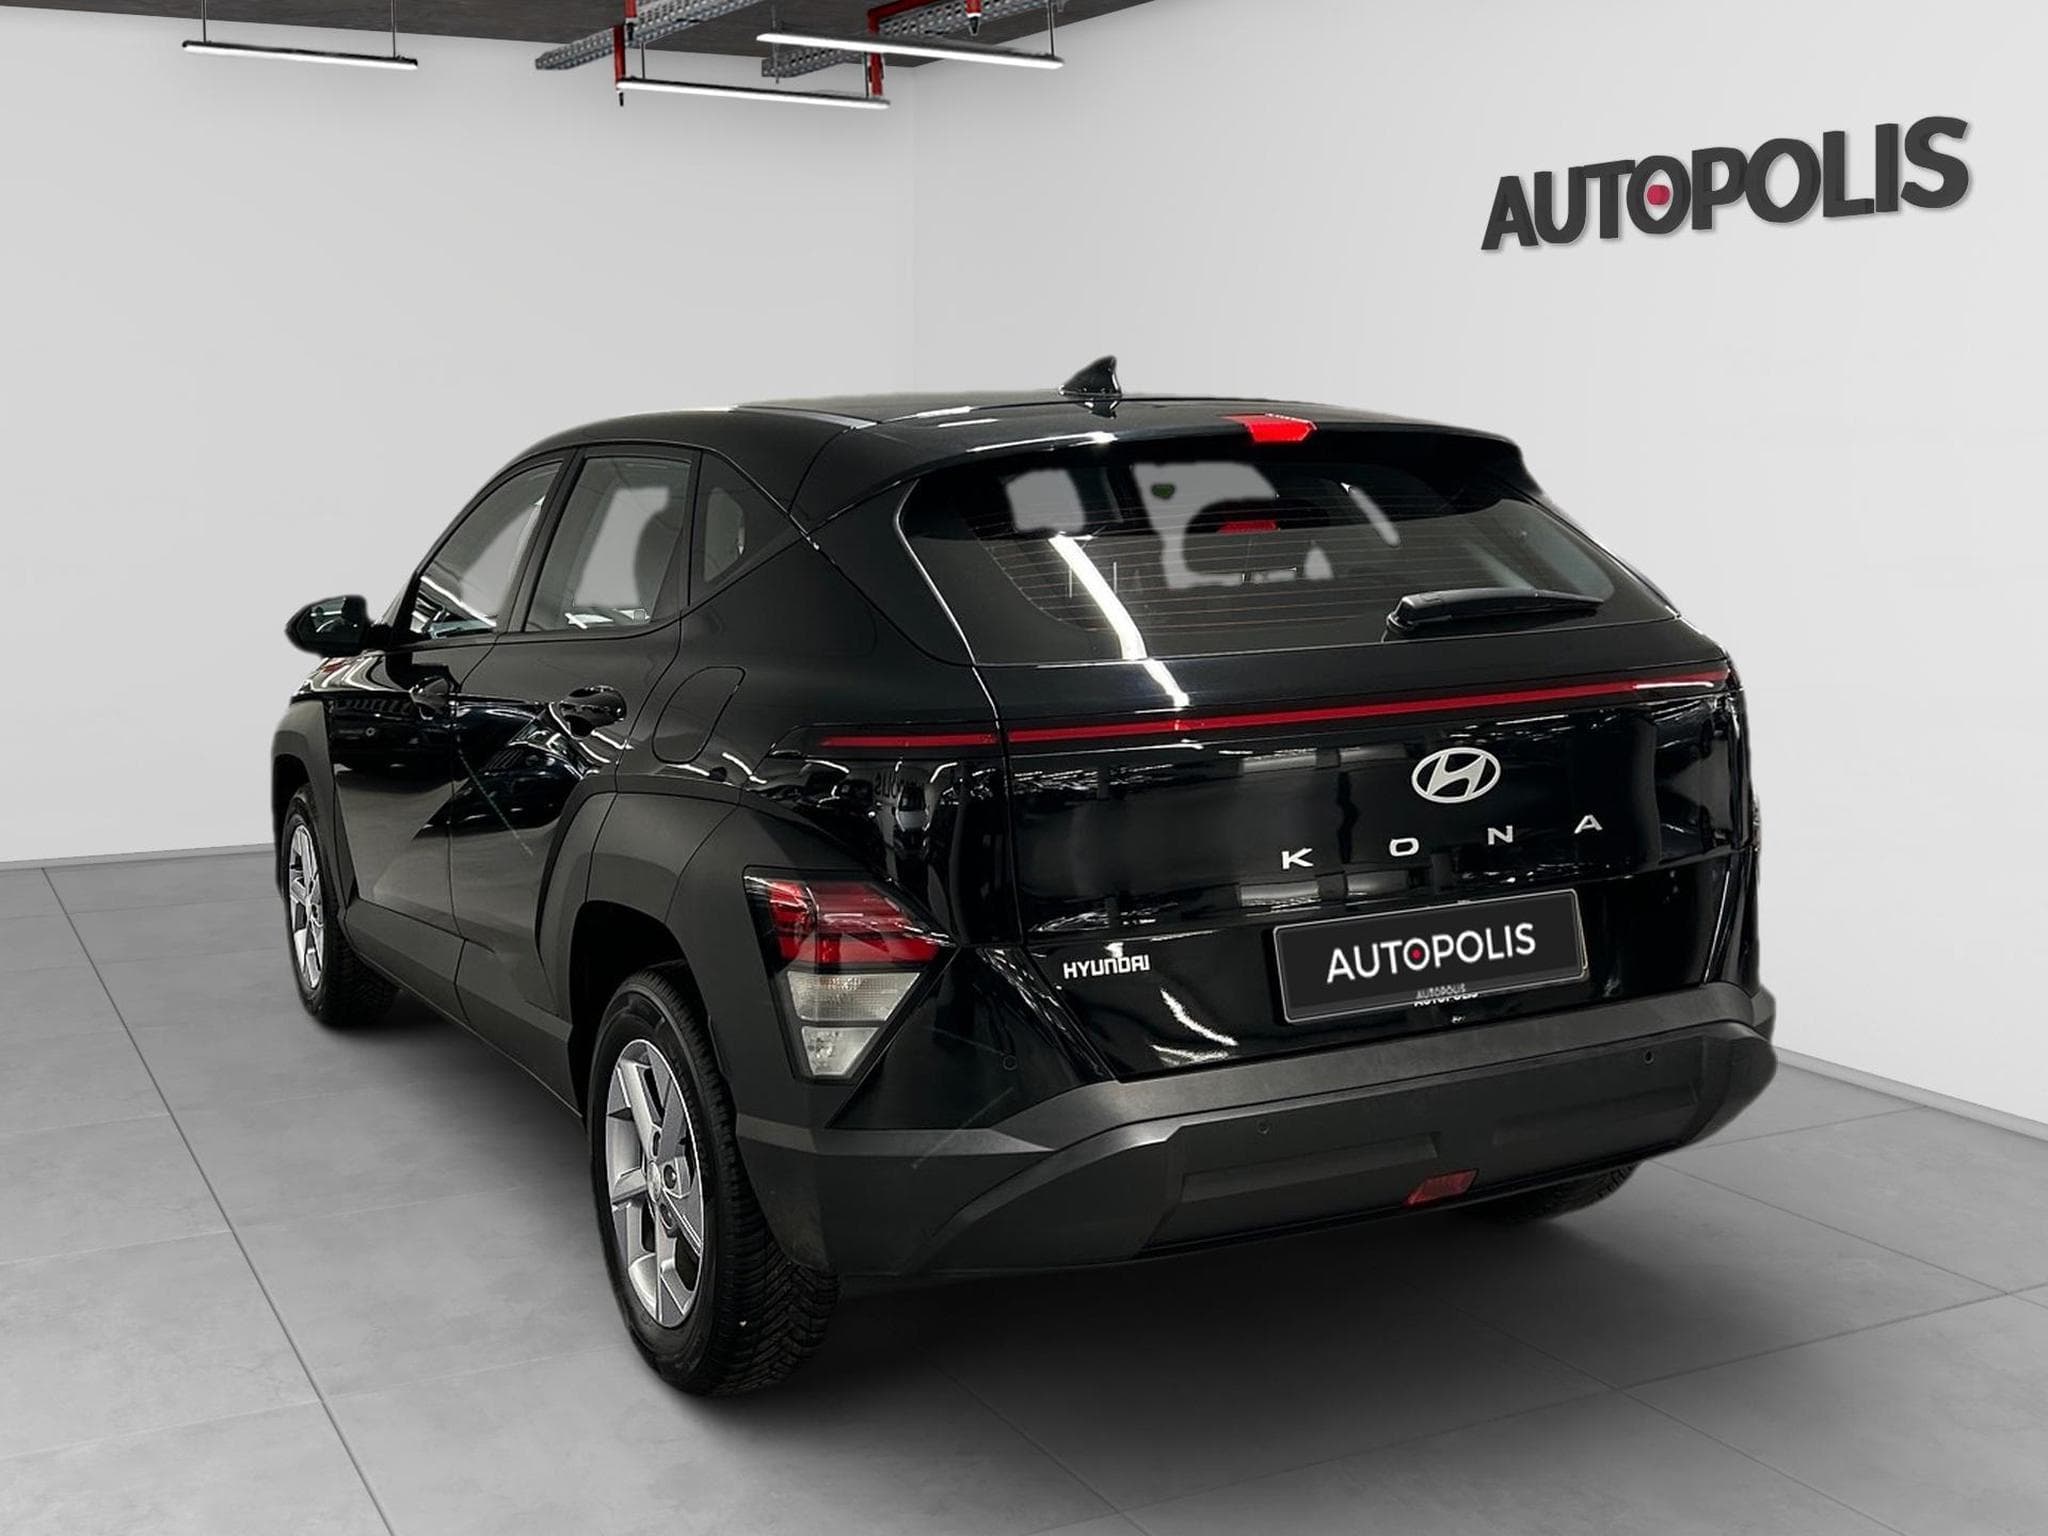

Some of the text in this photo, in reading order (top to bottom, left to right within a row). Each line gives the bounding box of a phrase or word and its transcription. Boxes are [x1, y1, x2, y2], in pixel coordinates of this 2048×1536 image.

[1480, 115, 1970, 251] AUTOPOLIS
[1281, 814, 1603, 871] KONA
[1063, 954, 1150, 979] HYUNDAI
[1326, 922, 1537, 985] AUTOPOLIS
